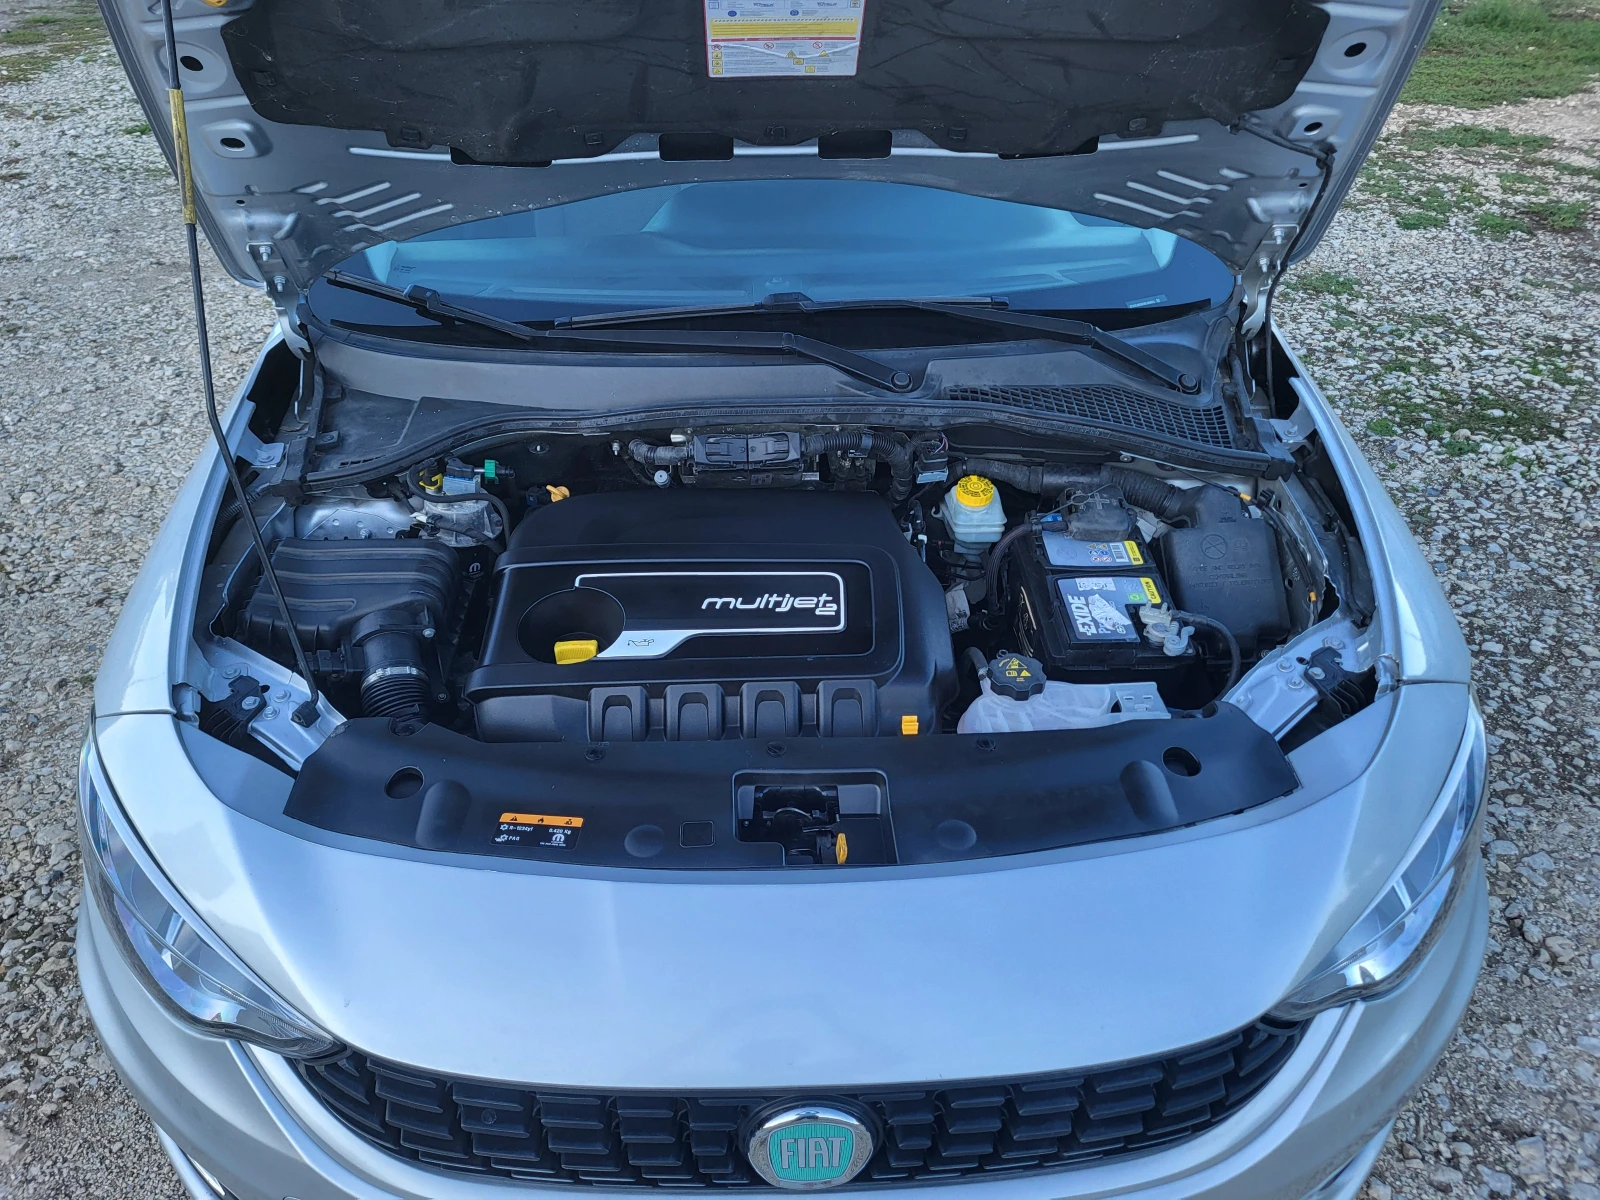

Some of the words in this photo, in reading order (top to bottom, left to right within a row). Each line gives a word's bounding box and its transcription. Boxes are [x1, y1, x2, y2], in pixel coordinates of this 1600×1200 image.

[1144, 581, 1157, 600] CAUTION
[1068, 594, 1098, 636] EXIDE
[779, 1137, 846, 1169] FIAT
